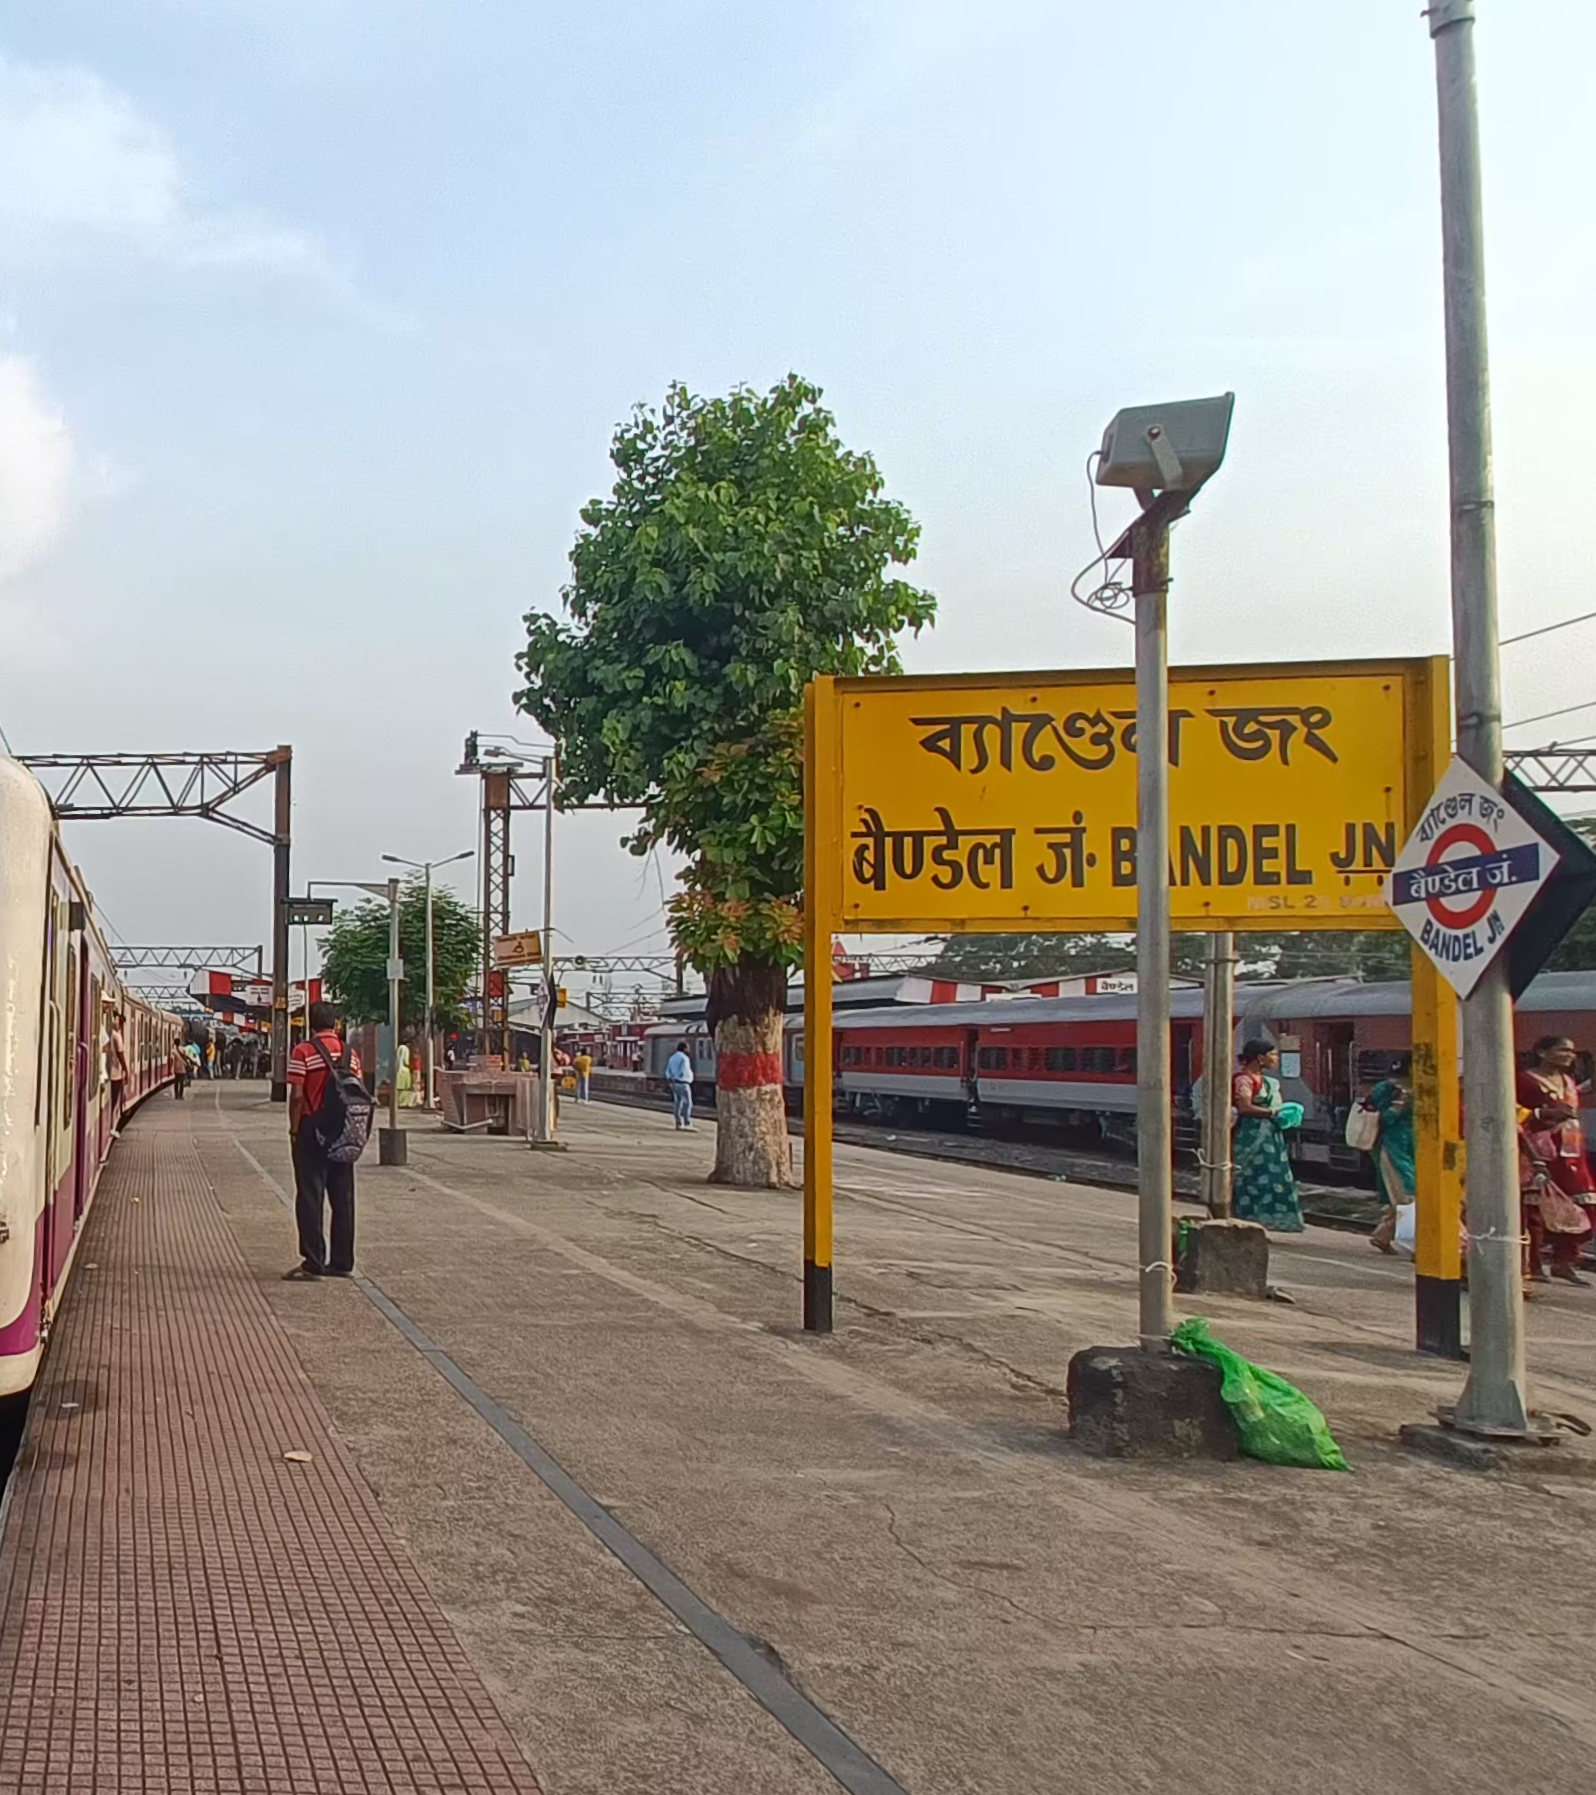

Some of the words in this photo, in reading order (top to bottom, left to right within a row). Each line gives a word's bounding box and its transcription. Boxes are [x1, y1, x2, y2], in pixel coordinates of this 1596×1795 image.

[1204, 705, 1339, 767] জং
[850, 806, 1016, 891] बैण्डेल
[1111, 823, 1313, 887] BNDEL
[1329, 822, 1396, 873] JN
[1410, 863, 1481, 898] बैण्डेल
[1420, 917, 1485, 962] BANDEL
